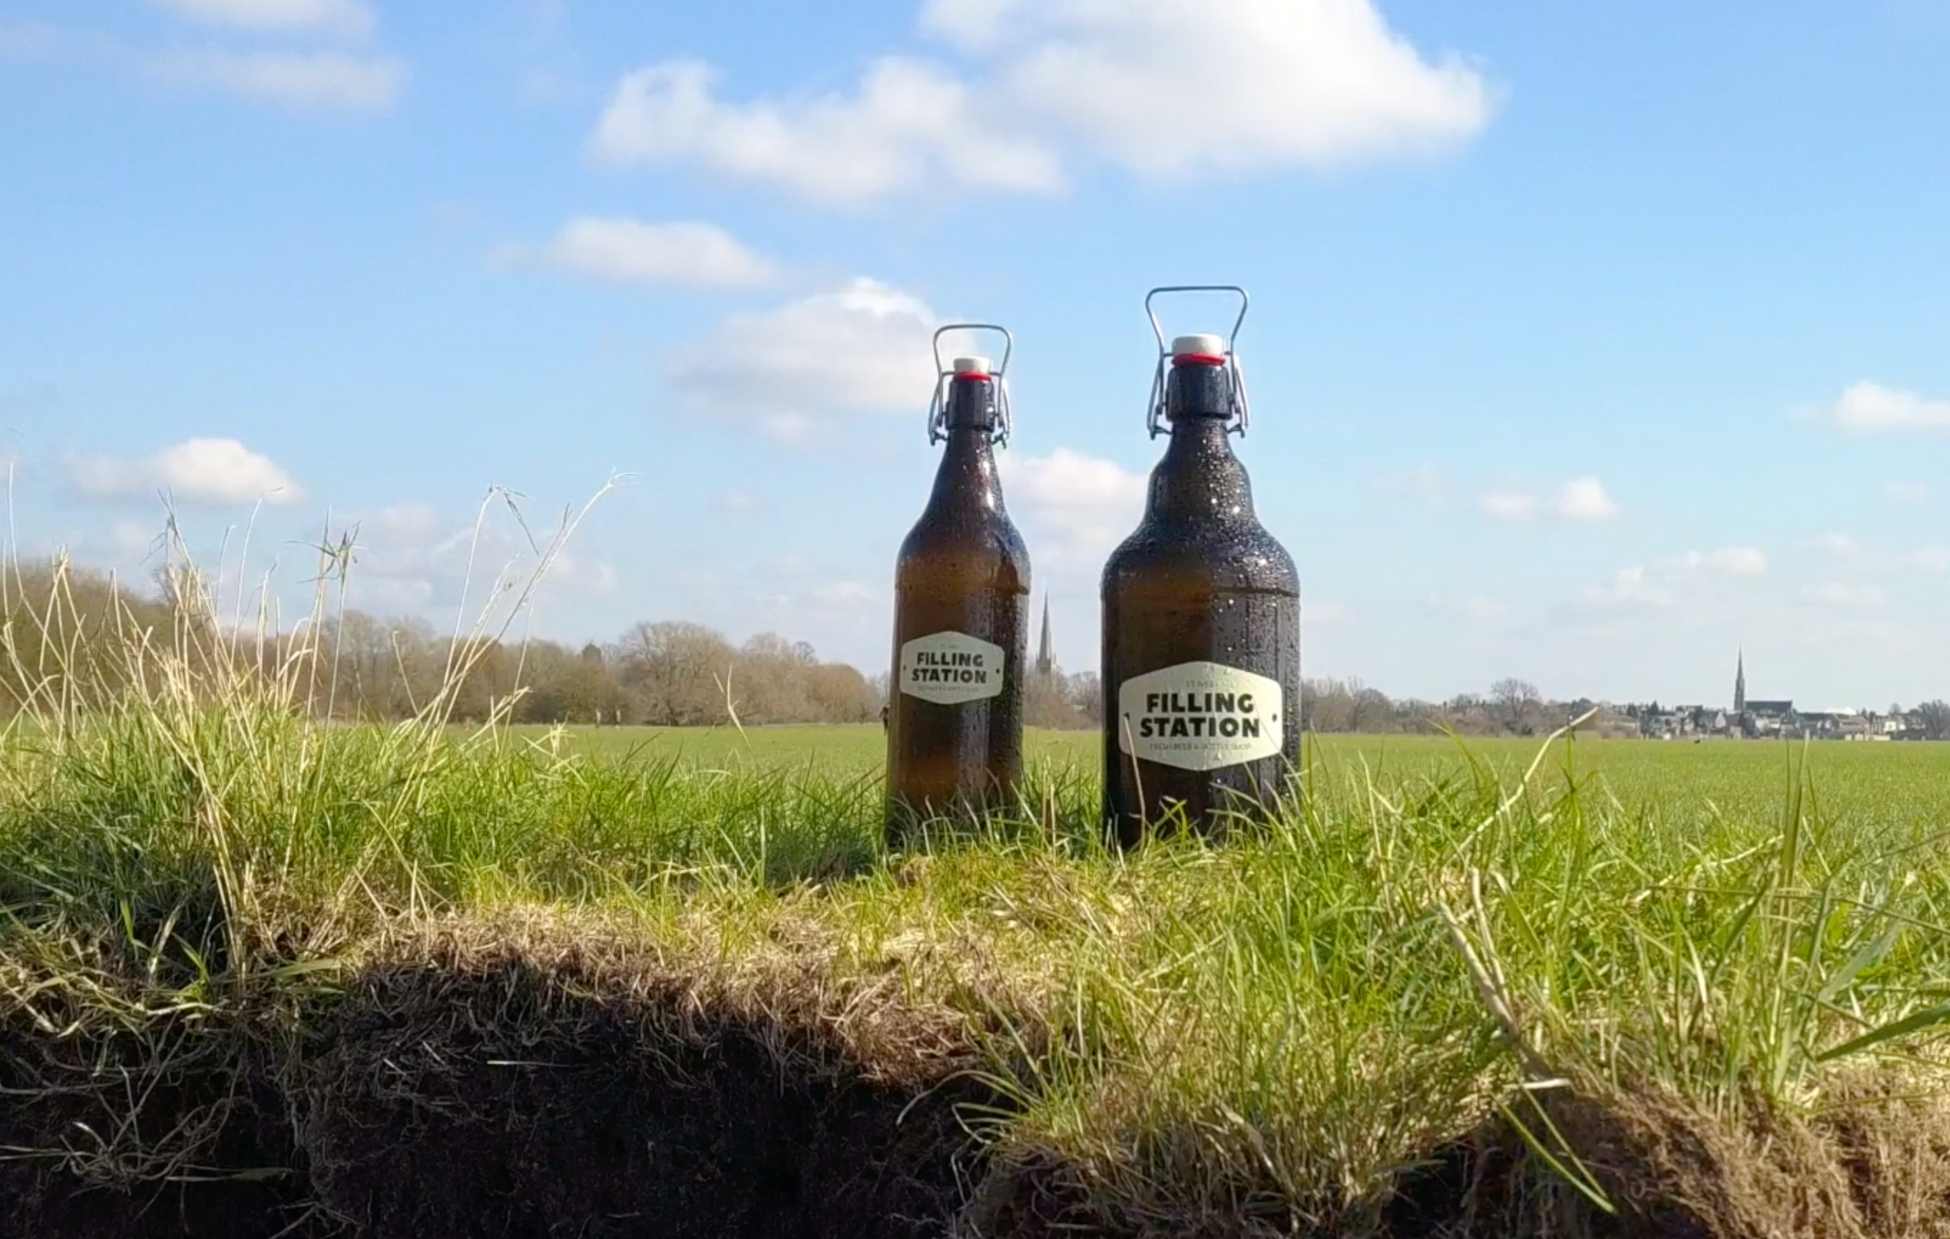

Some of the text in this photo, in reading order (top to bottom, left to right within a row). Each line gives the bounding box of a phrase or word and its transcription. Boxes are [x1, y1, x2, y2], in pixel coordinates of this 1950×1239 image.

[917, 652, 983, 667] FILLING
[912, 668, 987, 684] STATION
[1146, 693, 1254, 713] FILLING
[1140, 717, 1260, 738] STATION
